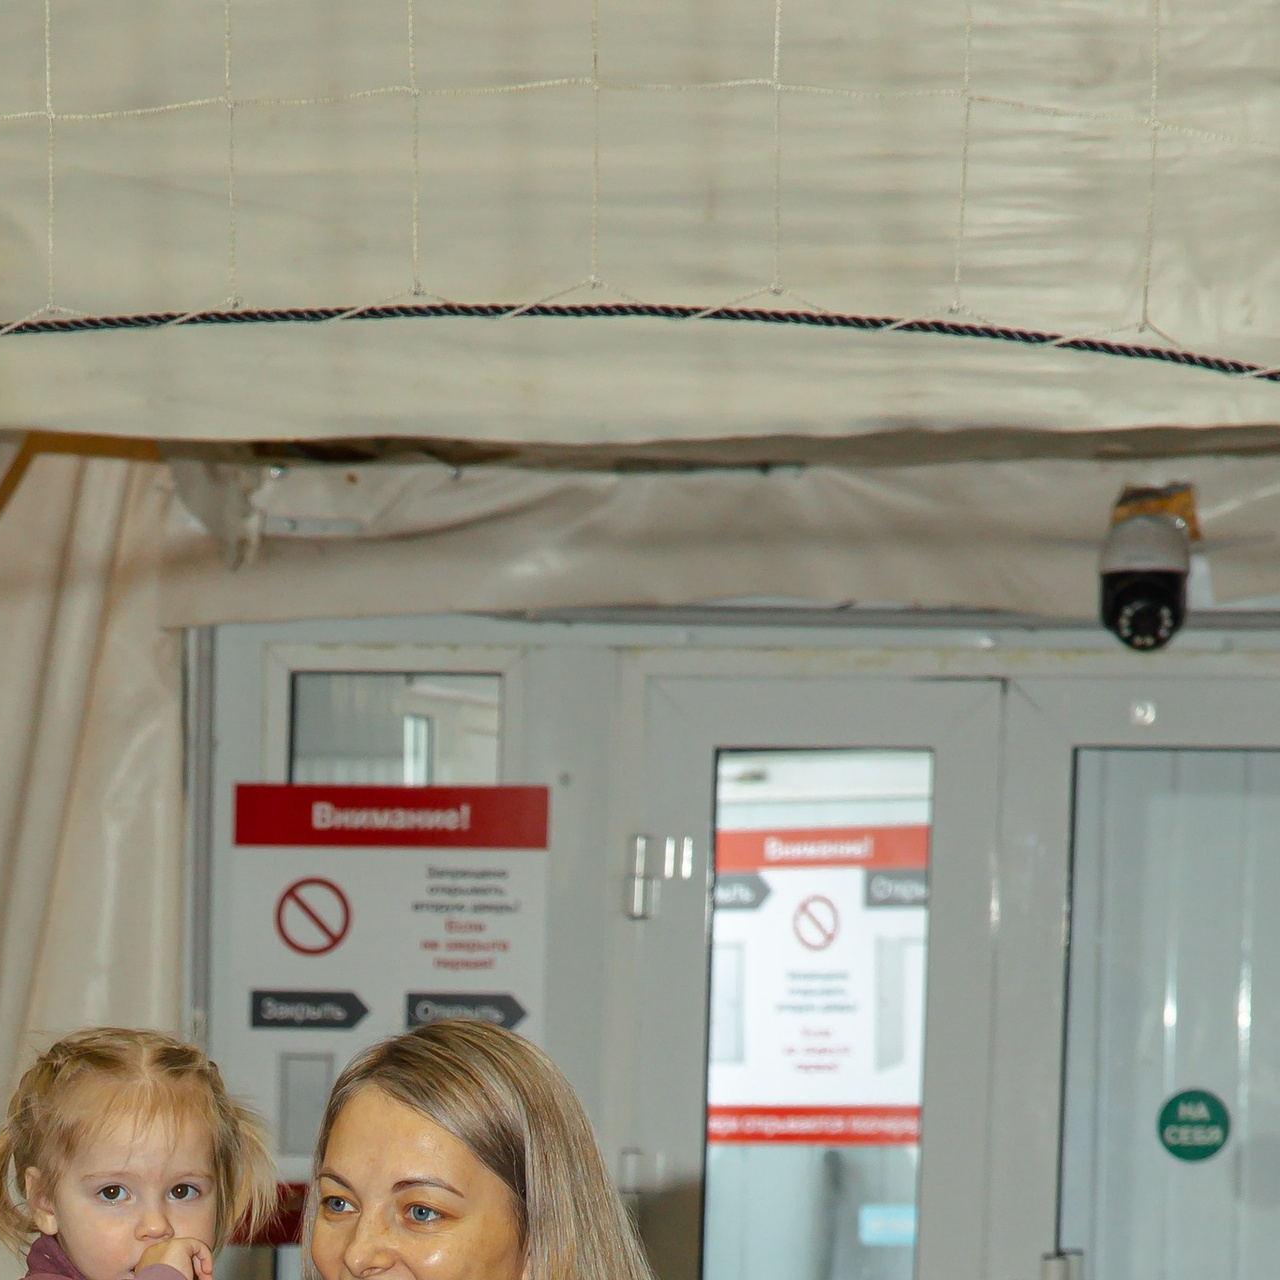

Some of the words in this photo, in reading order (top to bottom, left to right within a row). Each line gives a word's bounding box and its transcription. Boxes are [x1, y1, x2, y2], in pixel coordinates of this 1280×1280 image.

[311, 800, 471, 832] Внимание!
[260, 996, 348, 1023] Закрыть
[1176, 1099, 1211, 1122] НА
[1163, 1123, 1223, 1147] СЕБЯ
